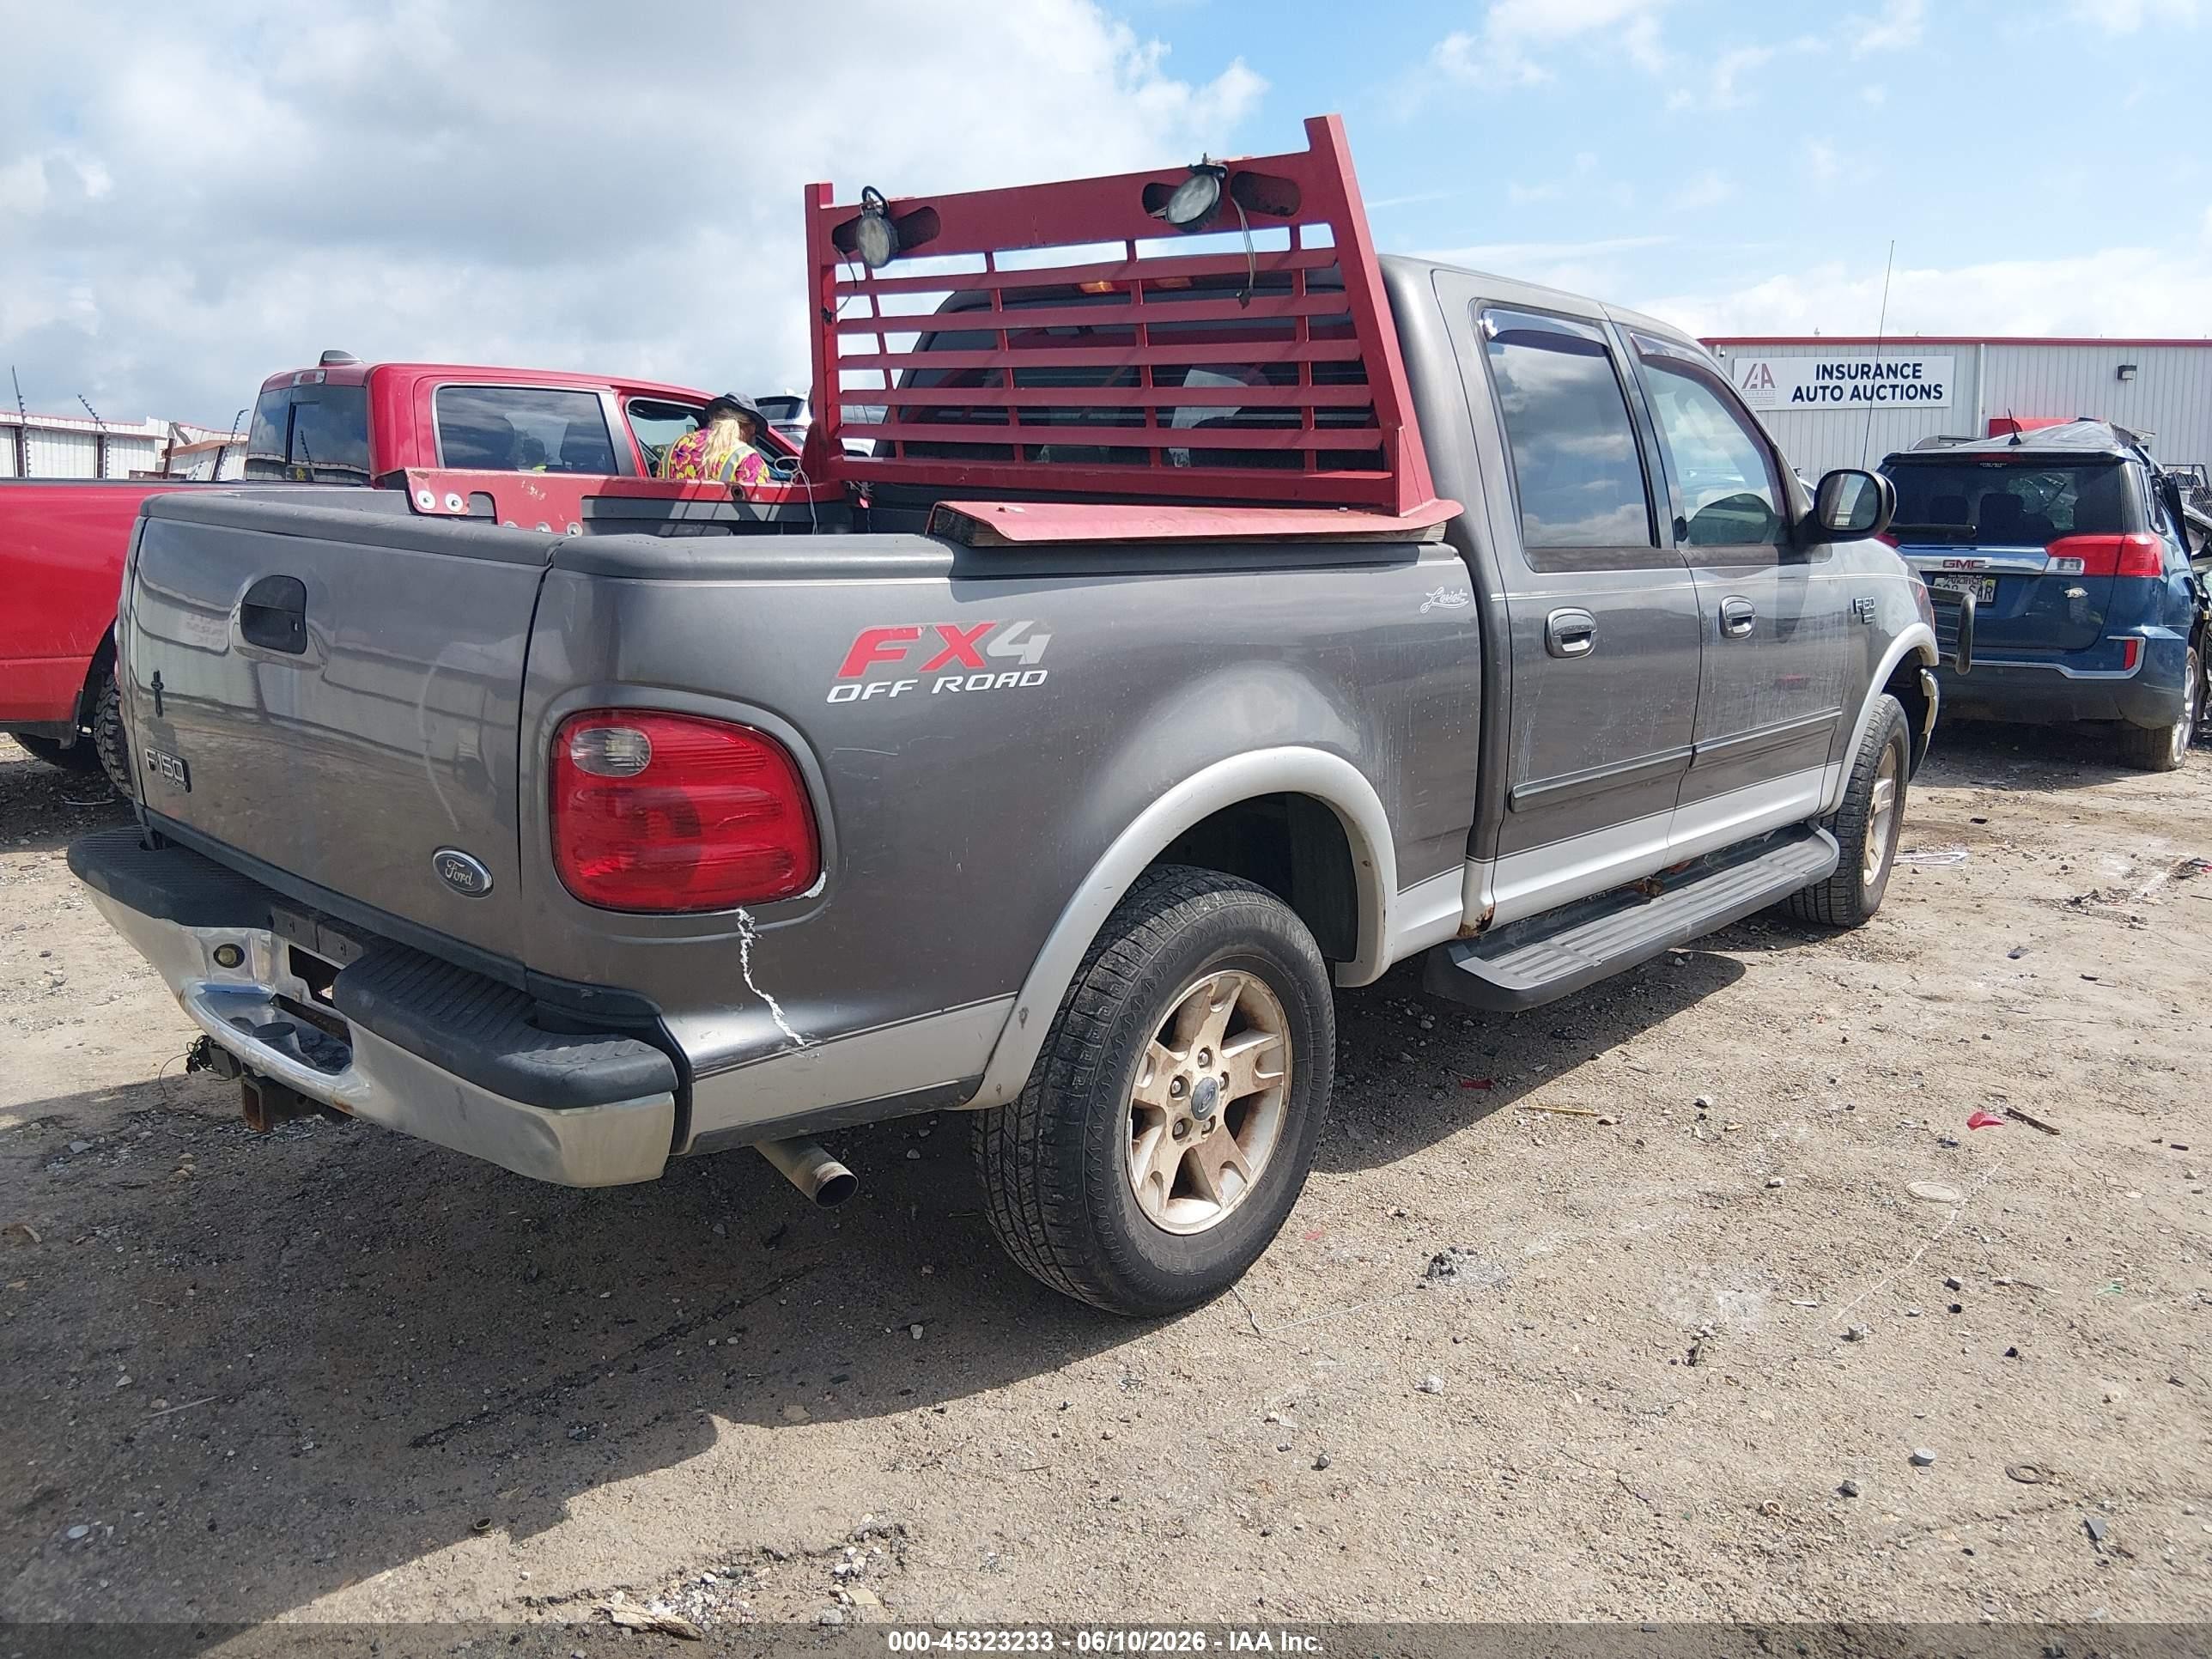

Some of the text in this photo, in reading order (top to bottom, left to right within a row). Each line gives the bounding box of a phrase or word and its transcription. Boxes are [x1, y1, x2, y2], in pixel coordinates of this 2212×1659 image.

[1815, 363, 1923, 380] INSURANCE
[1791, 384, 1943, 402] AUTO AUCTIONS
[1942, 560, 1985, 568] GMC
[838, 620, 1052, 678] FX4
[826, 670, 1049, 704] OFF ROAD
[446, 859, 473, 886] Ford
